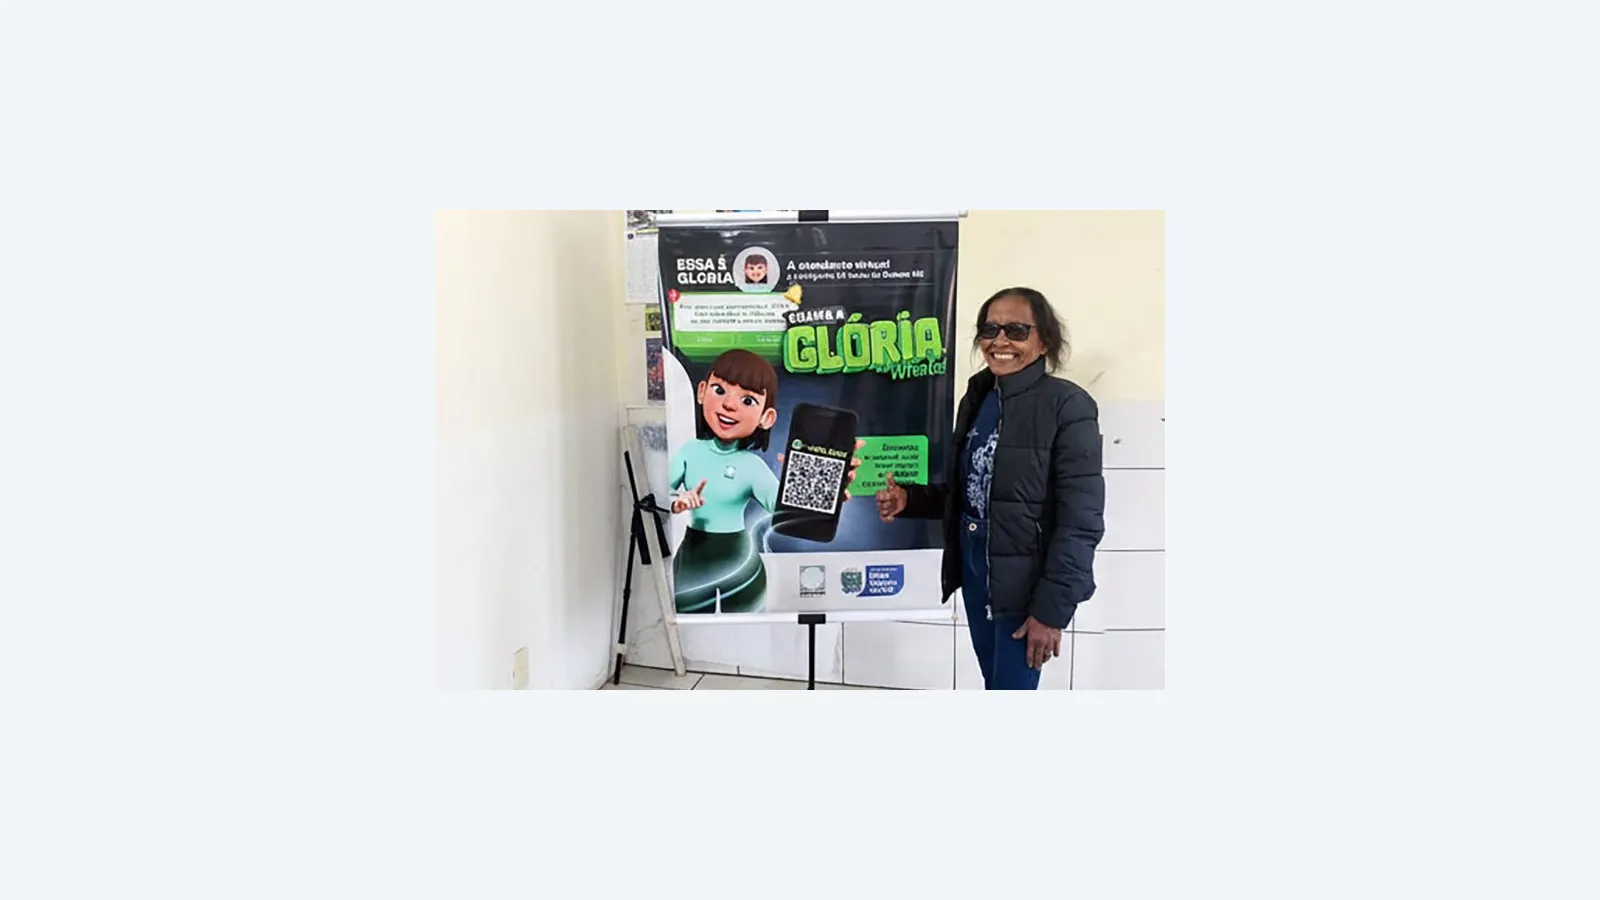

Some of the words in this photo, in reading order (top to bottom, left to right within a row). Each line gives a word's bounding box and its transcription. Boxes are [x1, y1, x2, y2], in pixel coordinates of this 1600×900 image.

[676, 258, 715, 271] ESSA
[786, 260, 796, 270] A
[835, 309, 845, 320] A
[784, 311, 943, 374] GLÓRIA
